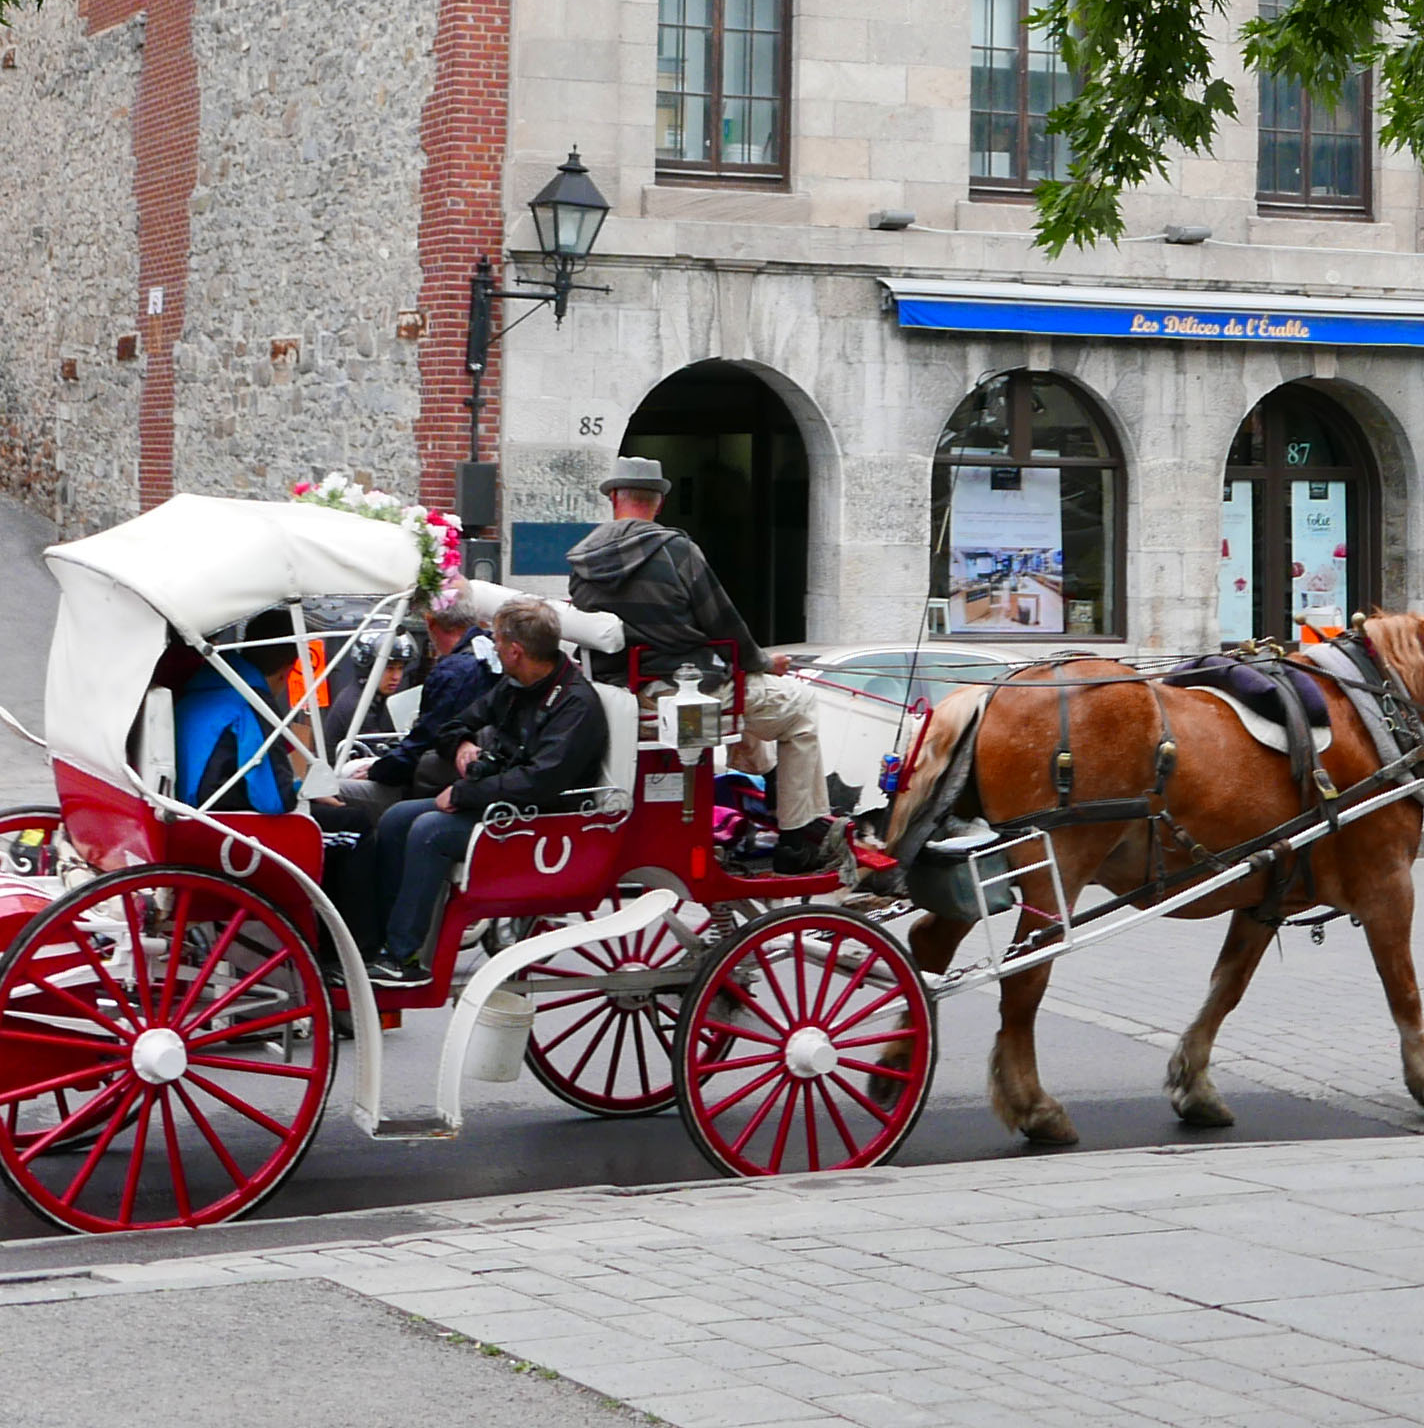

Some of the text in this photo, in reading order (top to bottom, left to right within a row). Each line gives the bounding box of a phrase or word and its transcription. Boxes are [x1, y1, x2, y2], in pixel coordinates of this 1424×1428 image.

[1130, 314, 1160, 333] Les
[1164, 314, 1221, 336] Délices
[1223, 318, 1244, 336] de
[579, 416, 604, 436] 85
[1287, 443, 1311, 464] 87
